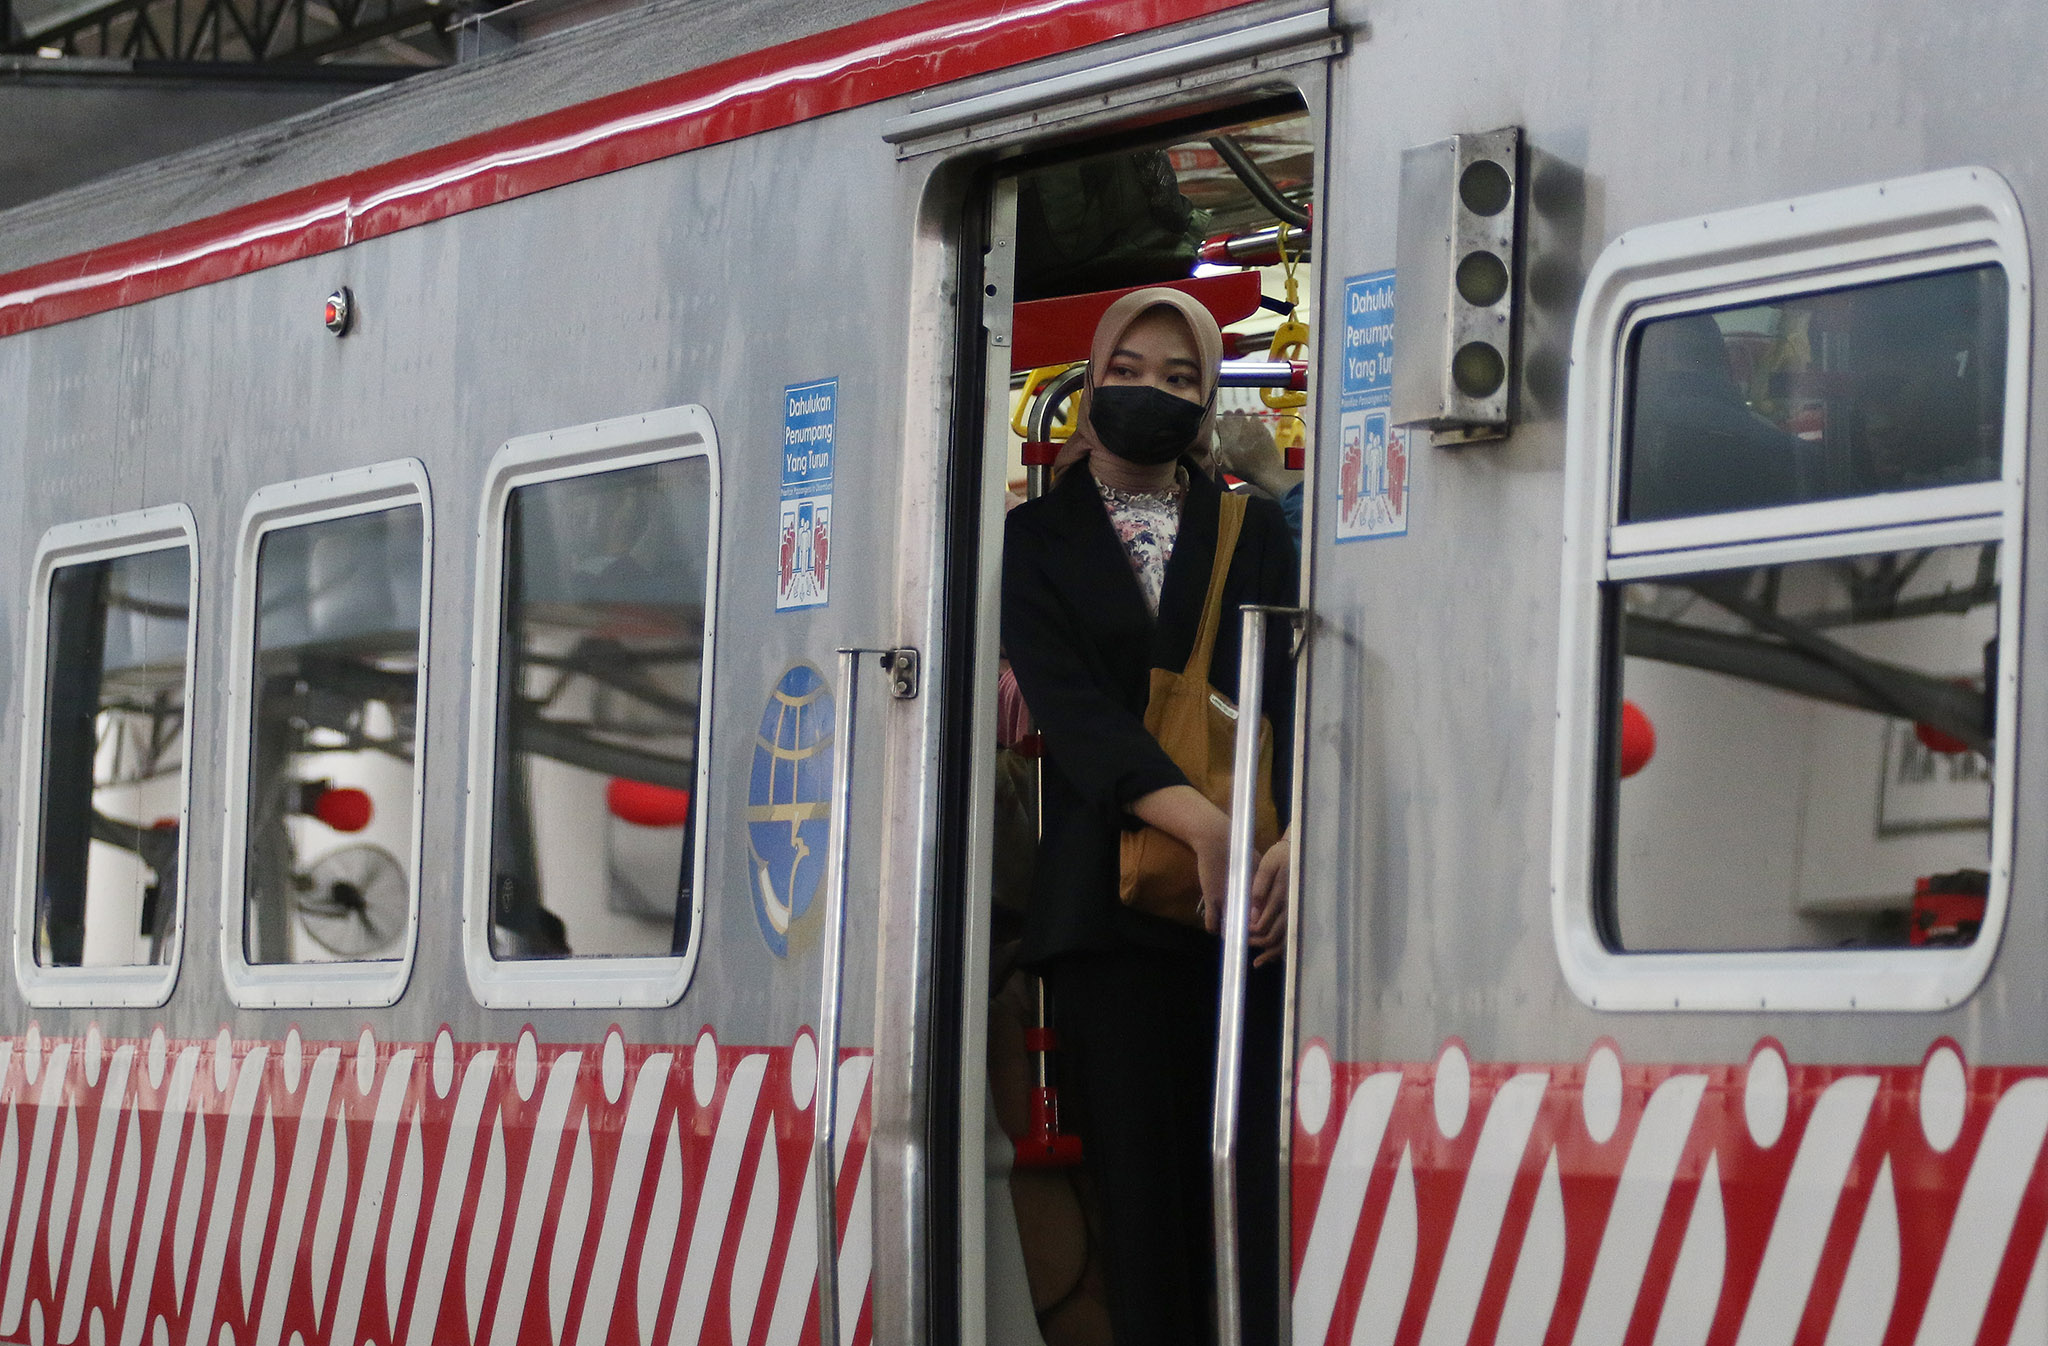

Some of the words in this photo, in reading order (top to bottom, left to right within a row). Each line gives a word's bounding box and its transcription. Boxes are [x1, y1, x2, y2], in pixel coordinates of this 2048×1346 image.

[1352, 285, 1394, 315] Dahuluk
[1347, 323, 1394, 348] Penump
[1348, 357, 1376, 382] Yang
[1377, 352, 1392, 375] Tur
[789, 392, 831, 417] Dahulukan
[785, 423, 833, 446] Penumpang
[786, 453, 807, 476] Yang
[808, 450, 829, 469] Turun
